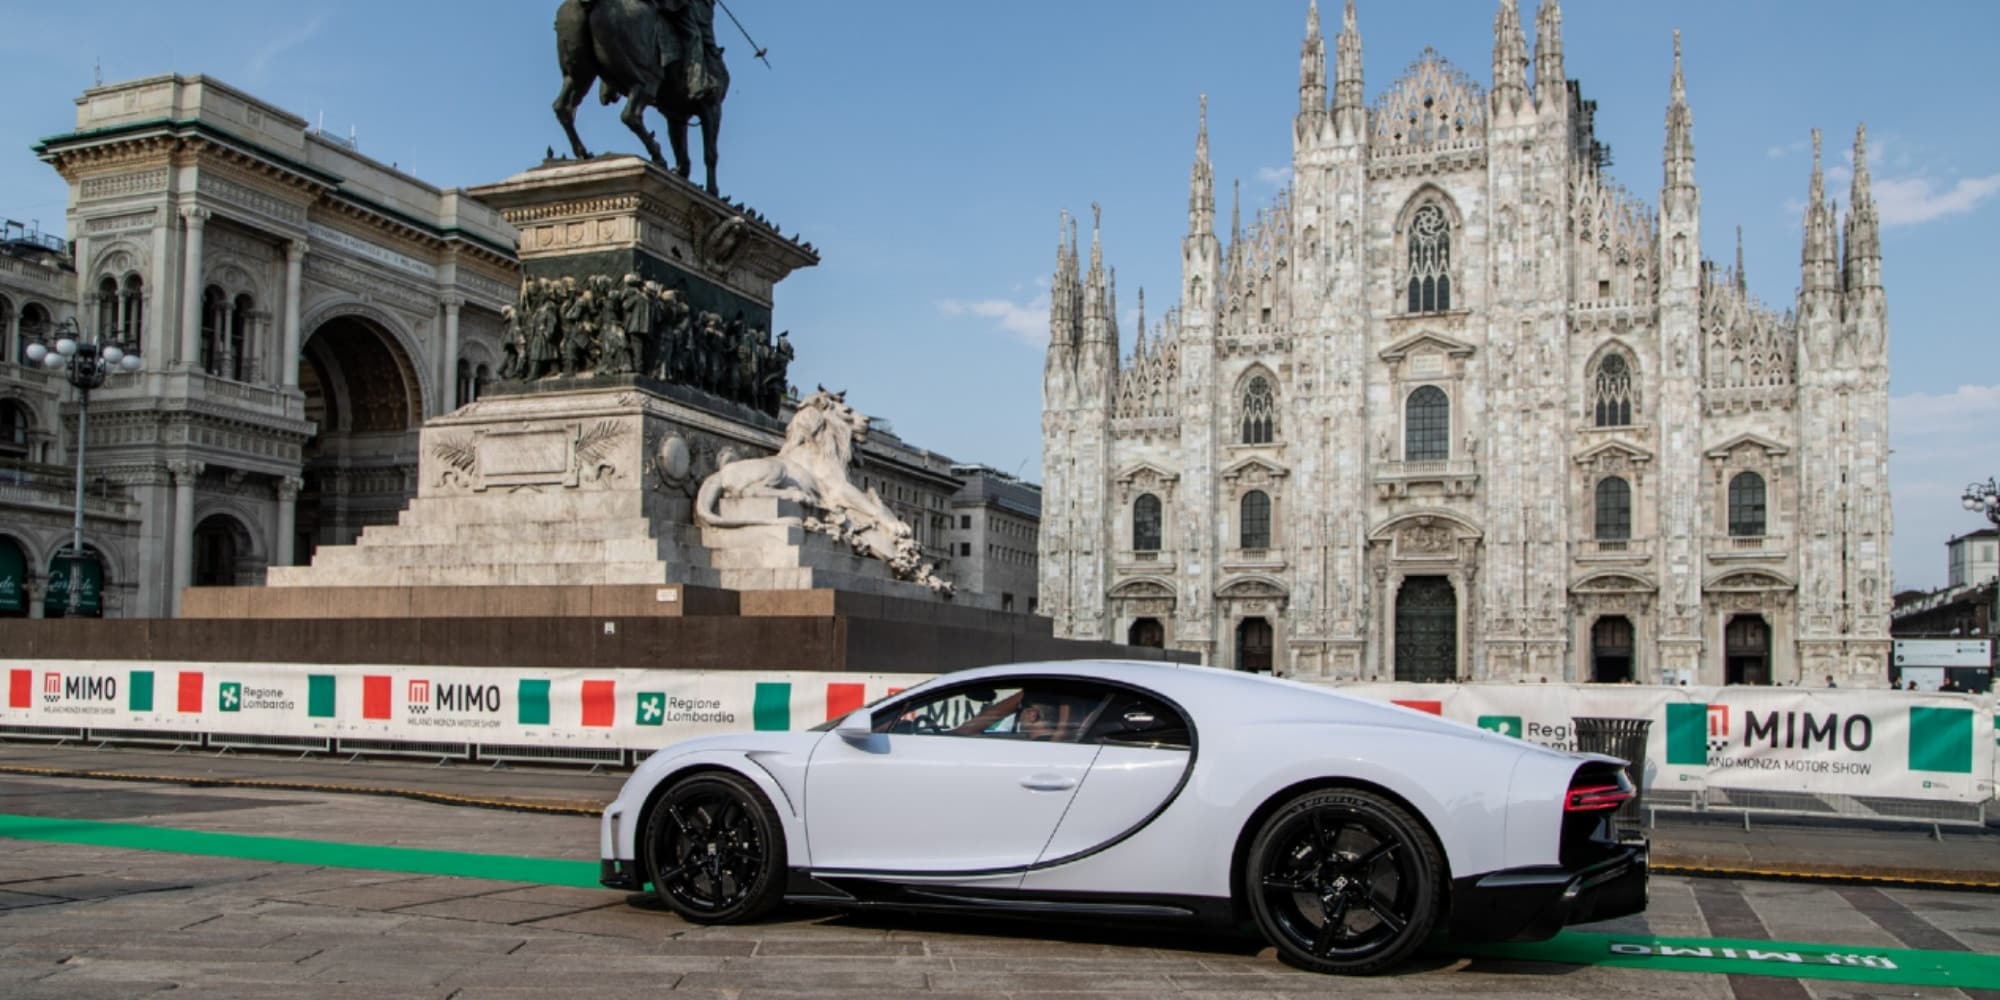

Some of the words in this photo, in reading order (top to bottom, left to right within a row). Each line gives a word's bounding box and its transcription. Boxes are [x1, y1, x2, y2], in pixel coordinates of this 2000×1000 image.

[65, 676, 117, 701] MIMO
[243, 686, 284, 699] Regione
[436, 683, 501, 713] MIMO
[243, 700, 295, 710] Lombardia
[669, 696, 721, 712] Regione
[667, 711, 735, 723] Lombardia
[1527, 721, 1578, 741] Regi
[1744, 710, 1873, 752] MIMO
[1735, 757, 1782, 771] MONZA
[1784, 760, 1829, 773] MOTOR
[1832, 761, 1871, 775] SHOW
[1610, 943, 1803, 963] MIMO
